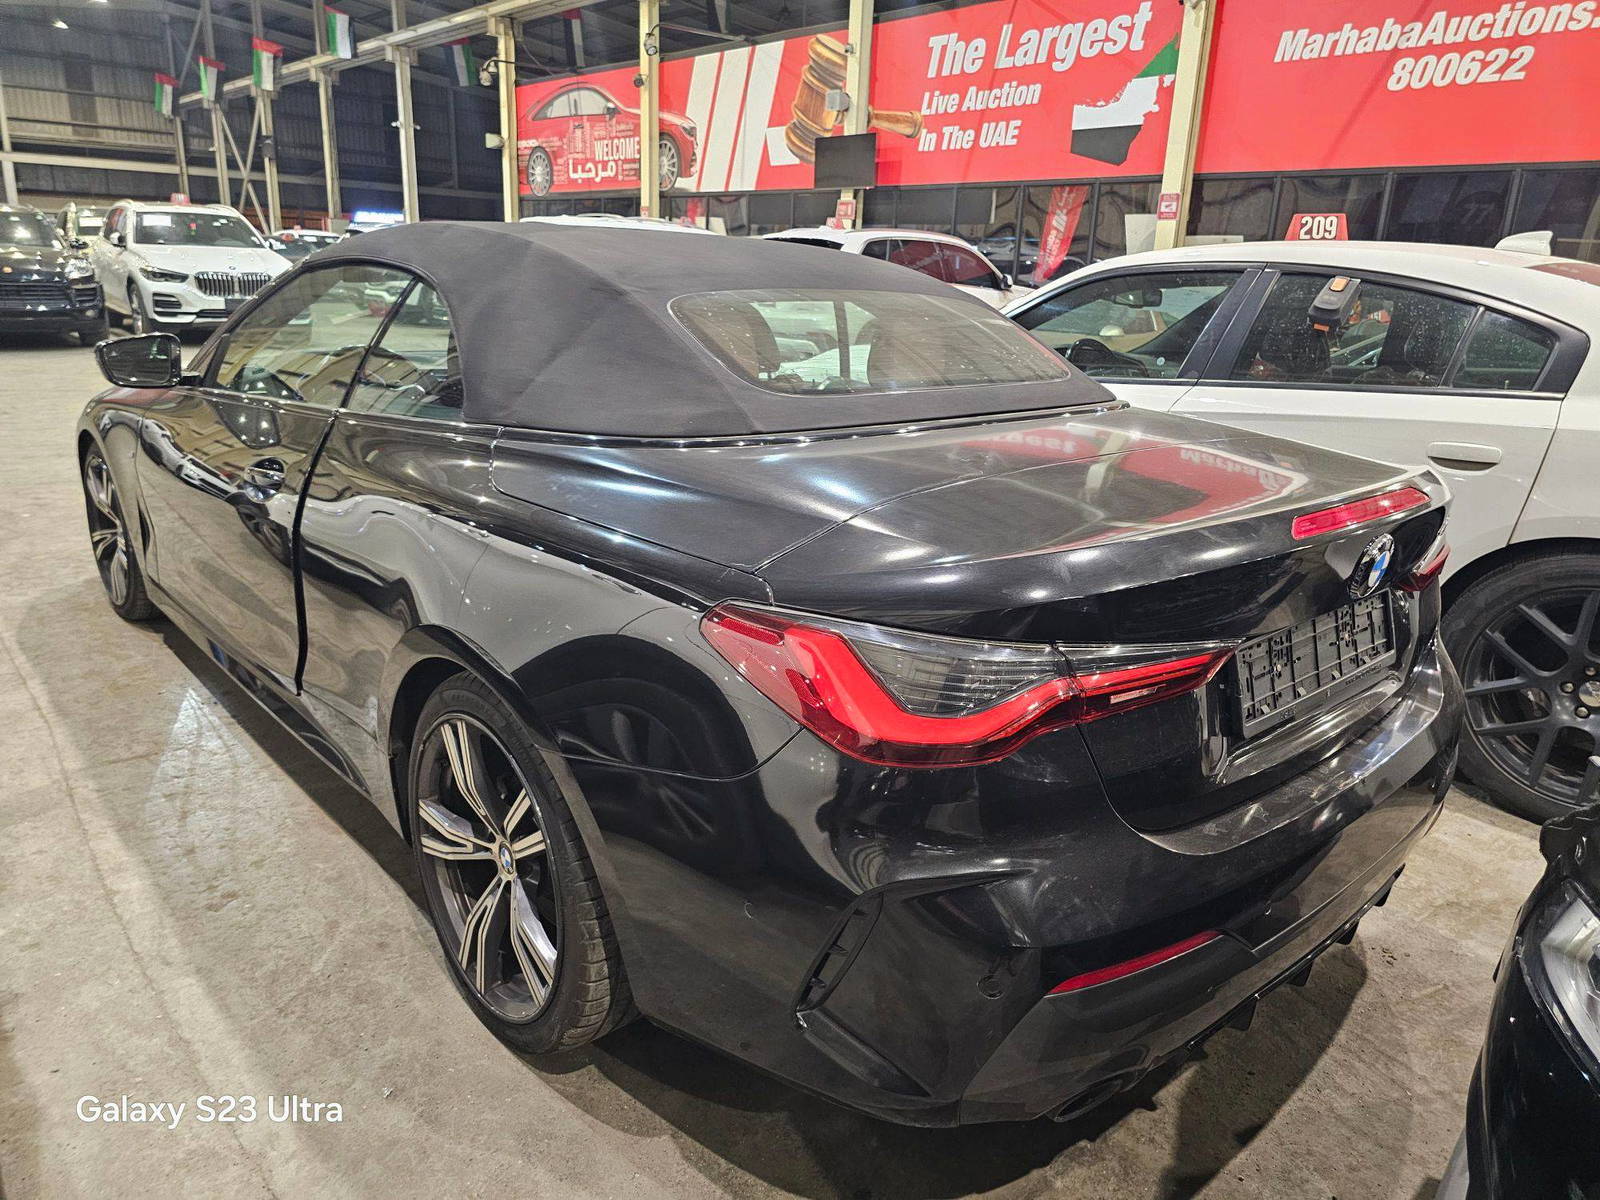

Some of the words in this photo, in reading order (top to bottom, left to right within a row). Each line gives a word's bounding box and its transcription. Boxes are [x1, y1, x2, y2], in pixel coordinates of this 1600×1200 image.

[927, 33, 986, 78] The
[994, 1, 1152, 72] Largest
[1386, 45, 1535, 92] 800622
[920, 90, 959, 116] Live
[961, 81, 1042, 112] Auction
[594, 137, 640, 161] WELCOME
[918, 129, 937, 152] In
[941, 125, 975, 150] The
[979, 120, 1022, 148] UAE
[568, 159, 616, 184] مرحبا
[1299, 216, 1338, 240] 209
